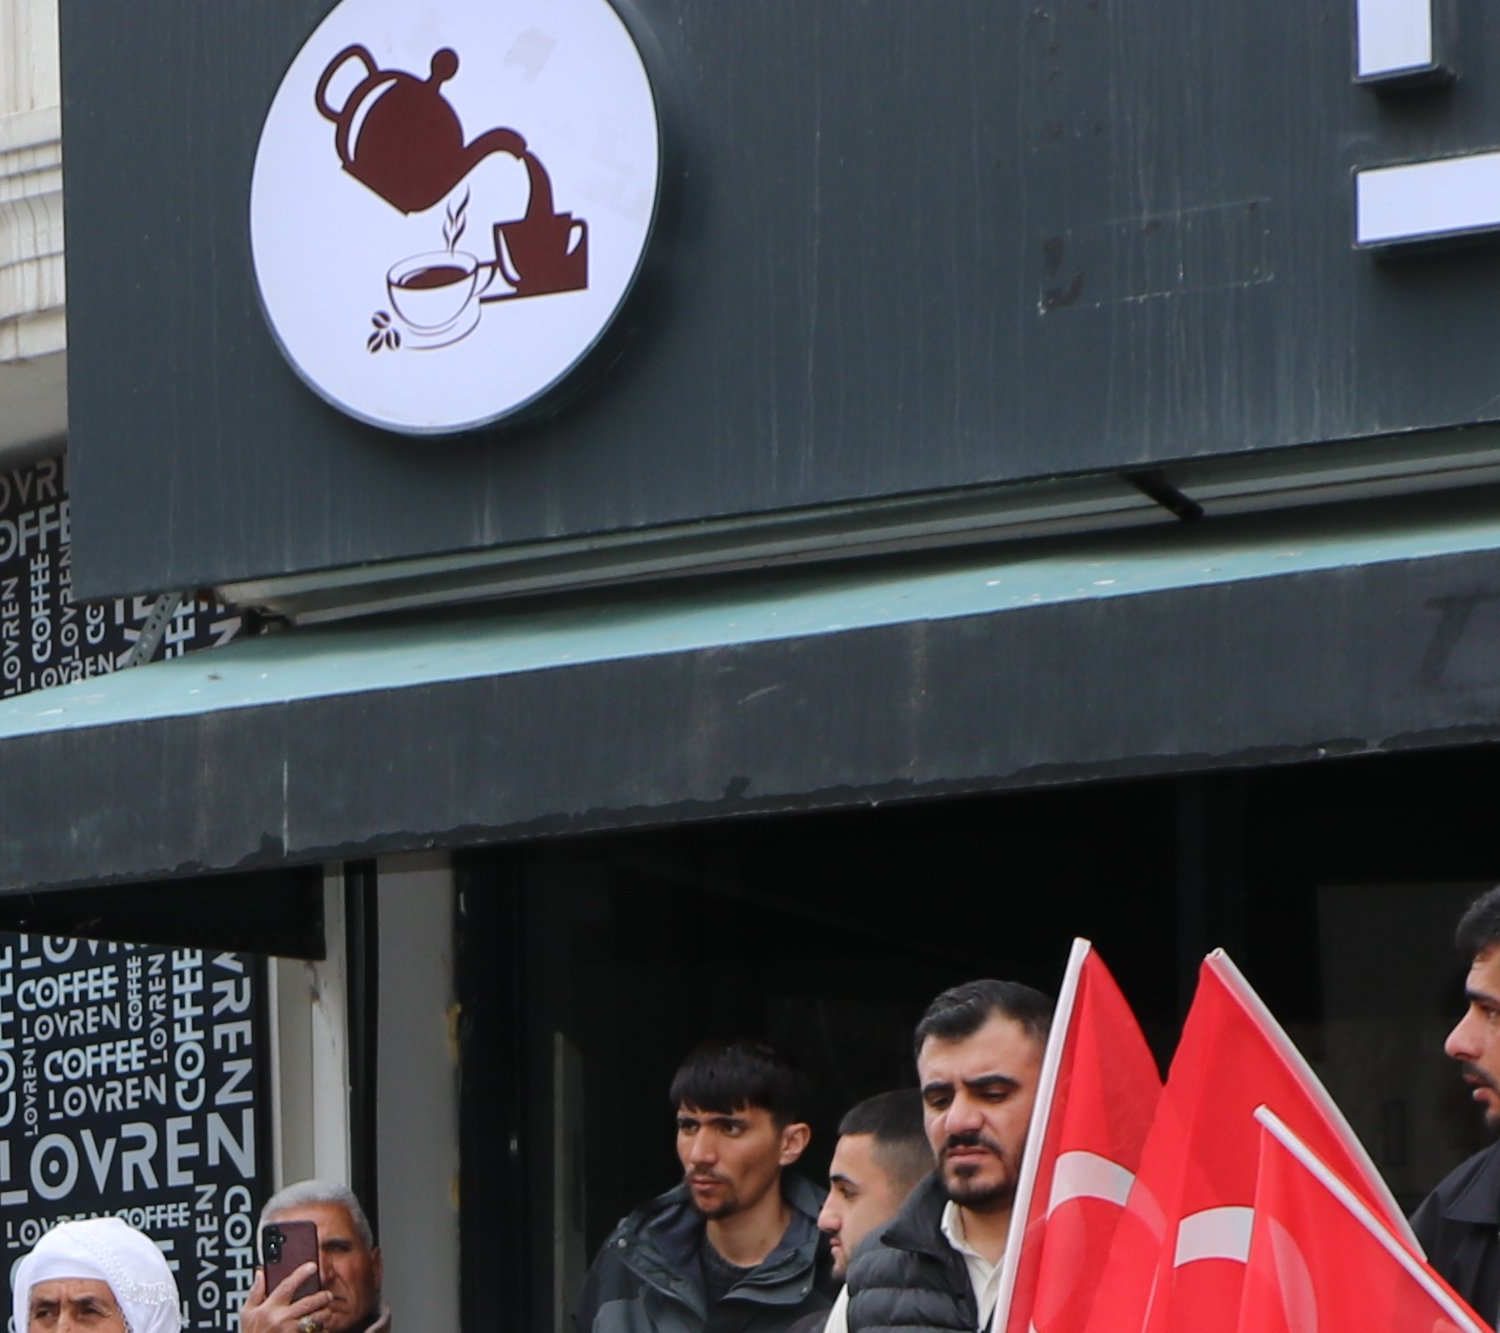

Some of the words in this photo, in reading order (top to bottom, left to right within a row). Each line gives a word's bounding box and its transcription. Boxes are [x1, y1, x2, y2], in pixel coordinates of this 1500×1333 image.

[1, 576, 22, 697] LOVREN
[30, 552, 52, 664] COFFEE
[16, 965, 119, 1011] COFFEE
[22, 1002, 121, 1044] LOVREN
[127, 955, 143, 1032] COFFEE
[148, 953, 168, 1065] LOVREN
[172, 947, 206, 1111] COFFEE
[22, 1048, 38, 1137] LOVREN
[43, 1038, 148, 1082] COFFEE
[48, 1073, 167, 1120] LOVREN
[0, 1107, 255, 1206] LOVREN
[194, 1183, 221, 1328] LOVREN
